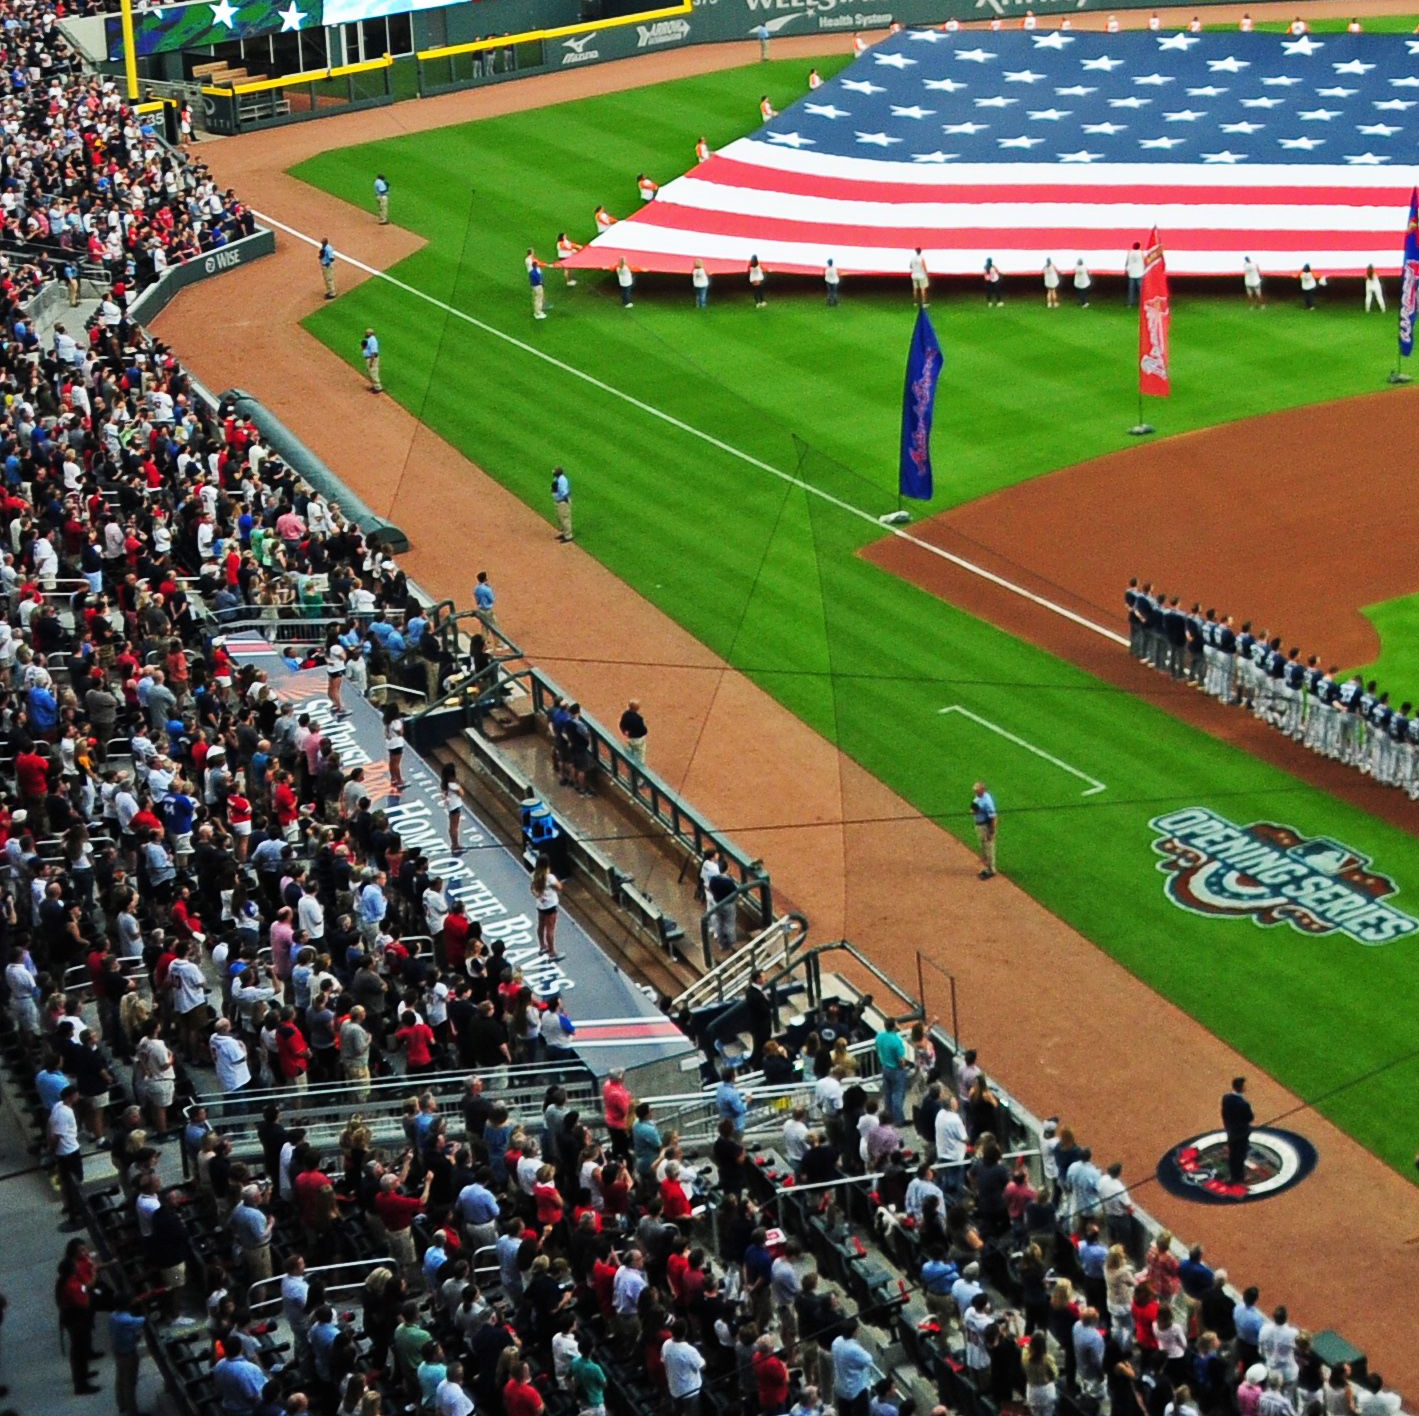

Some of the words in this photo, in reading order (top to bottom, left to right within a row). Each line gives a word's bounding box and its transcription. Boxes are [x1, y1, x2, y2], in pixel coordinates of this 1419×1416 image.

[819, 13, 852, 29] Health
[855, 12, 893, 29] System
[383, 799, 456, 858] HOME
[448, 873, 508, 923] THE
[483, 912, 575, 998] BRAVES
[1156, 809, 1308, 884] OPENING
[1281, 874, 1417, 940] SERIES
